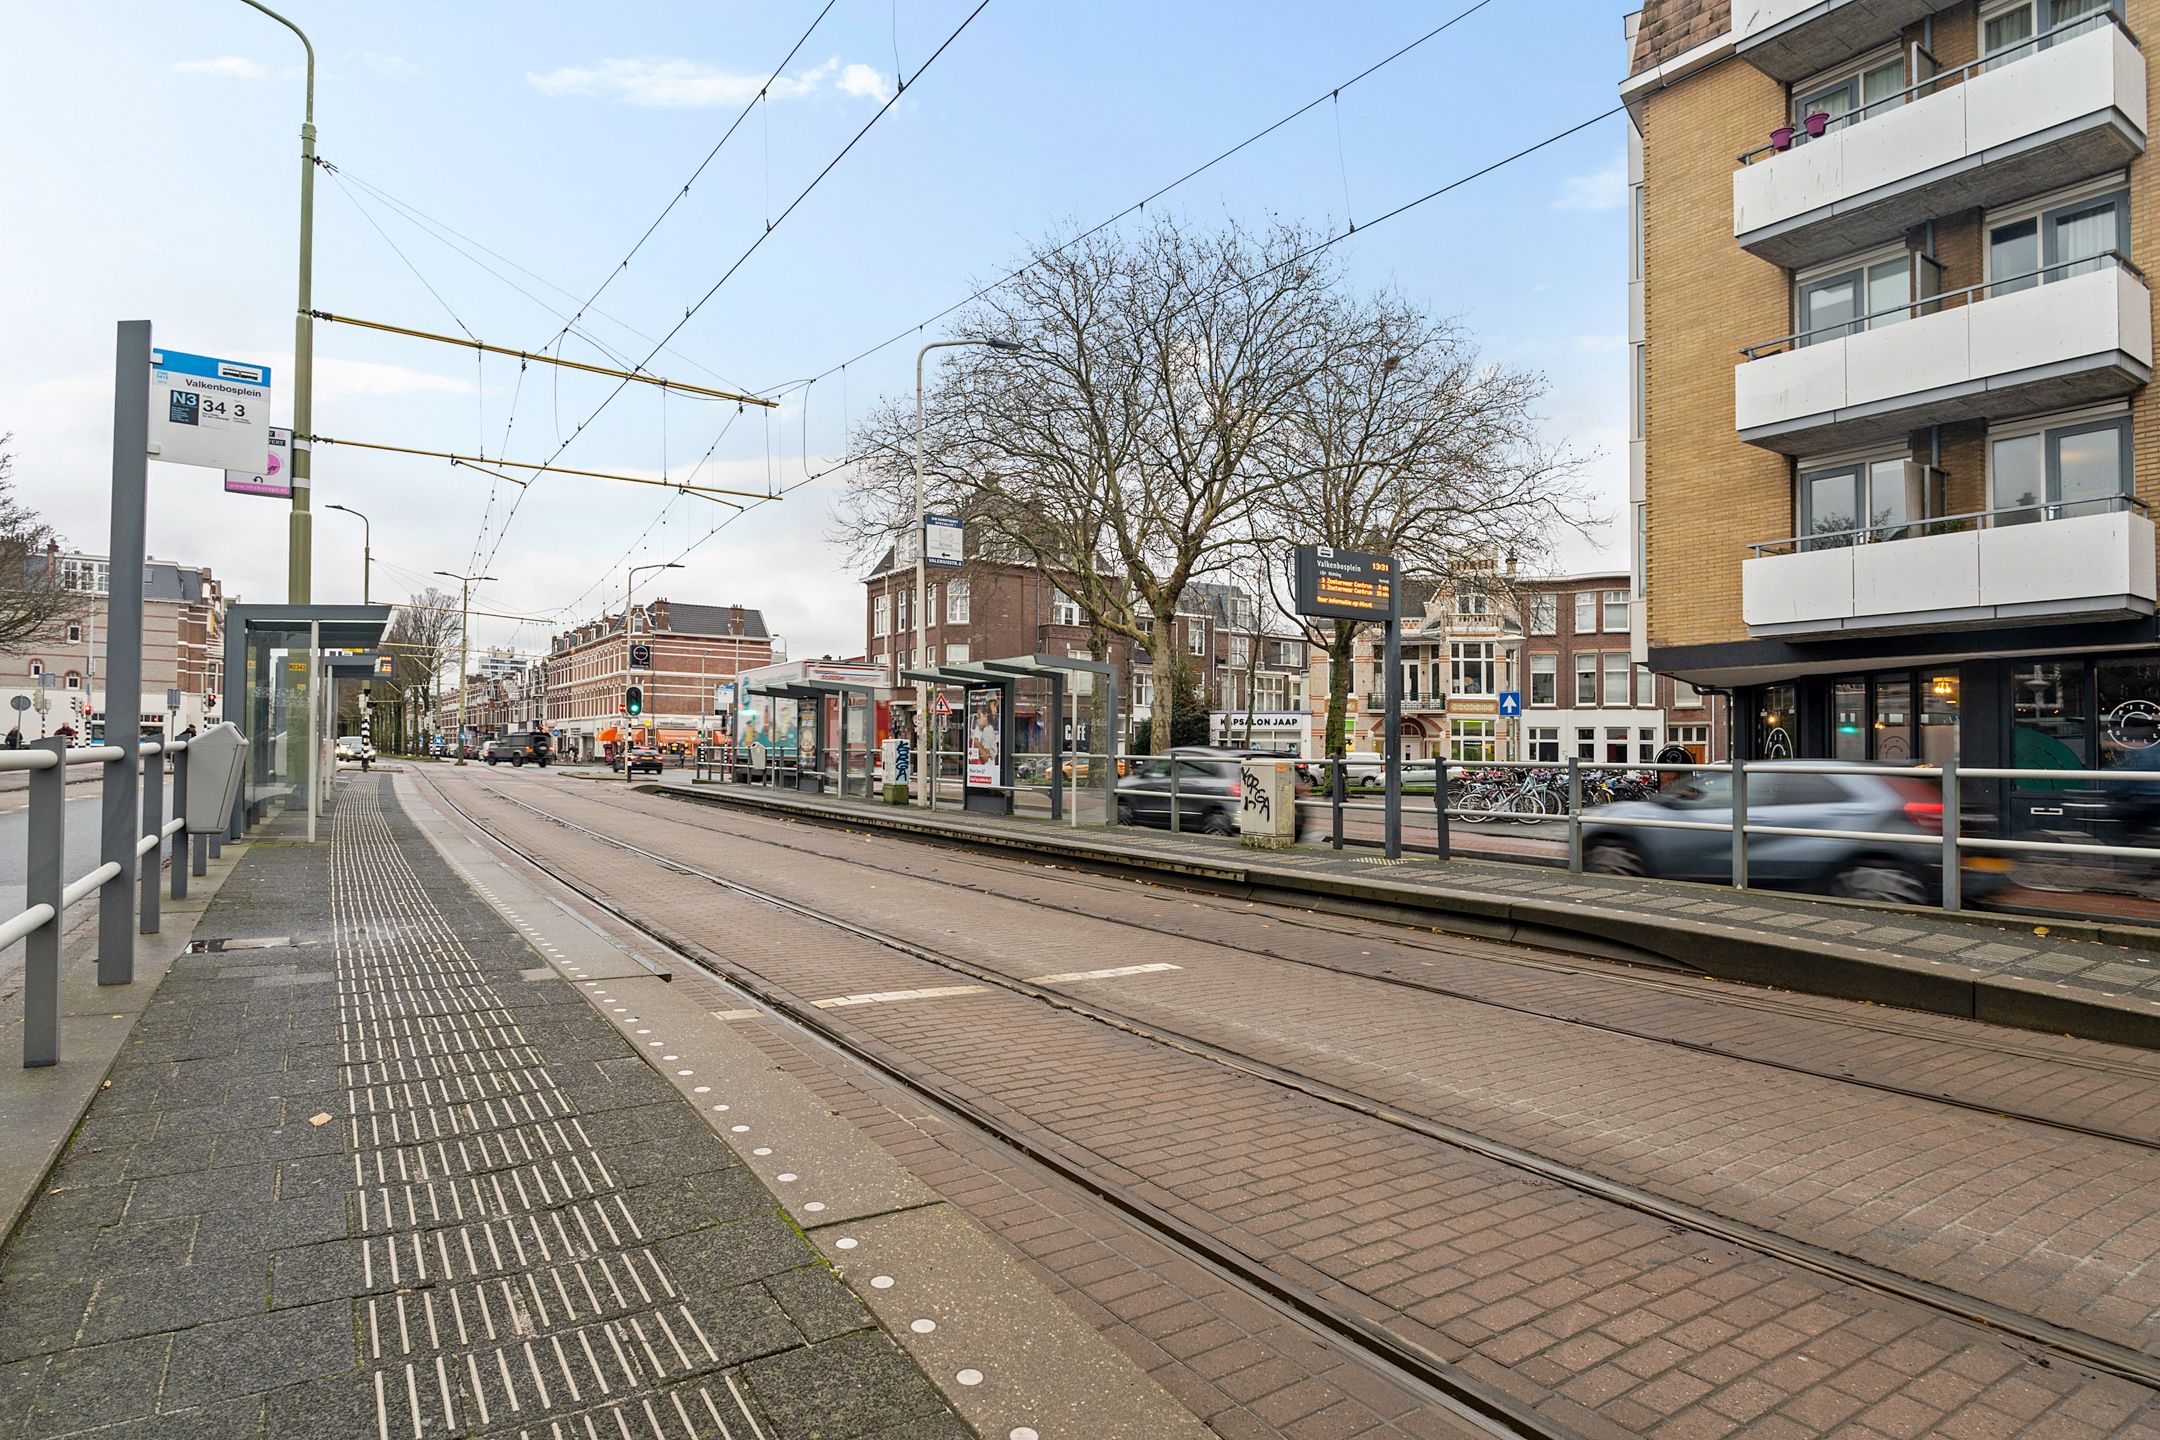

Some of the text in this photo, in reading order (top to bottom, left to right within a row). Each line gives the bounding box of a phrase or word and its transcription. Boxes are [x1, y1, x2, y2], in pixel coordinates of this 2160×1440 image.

[185, 378, 262, 398] Valkenbosplein
[173, 391, 197, 406] N3
[202, 400, 226, 415] 34
[234, 404, 246, 417] 3
[1317, 560, 1389, 572] Valkenbosplein 13:31
[1327, 578, 1353, 587] Zoetermeer
[1354, 581, 1373, 589] Centrum
[1327, 584, 1353, 593] Zoetermeer
[2118, 704, 2145, 715] FIT
[1220, 718, 1298, 726] KPSLON JAAP
[1064, 723, 1086, 741] CFÉ
